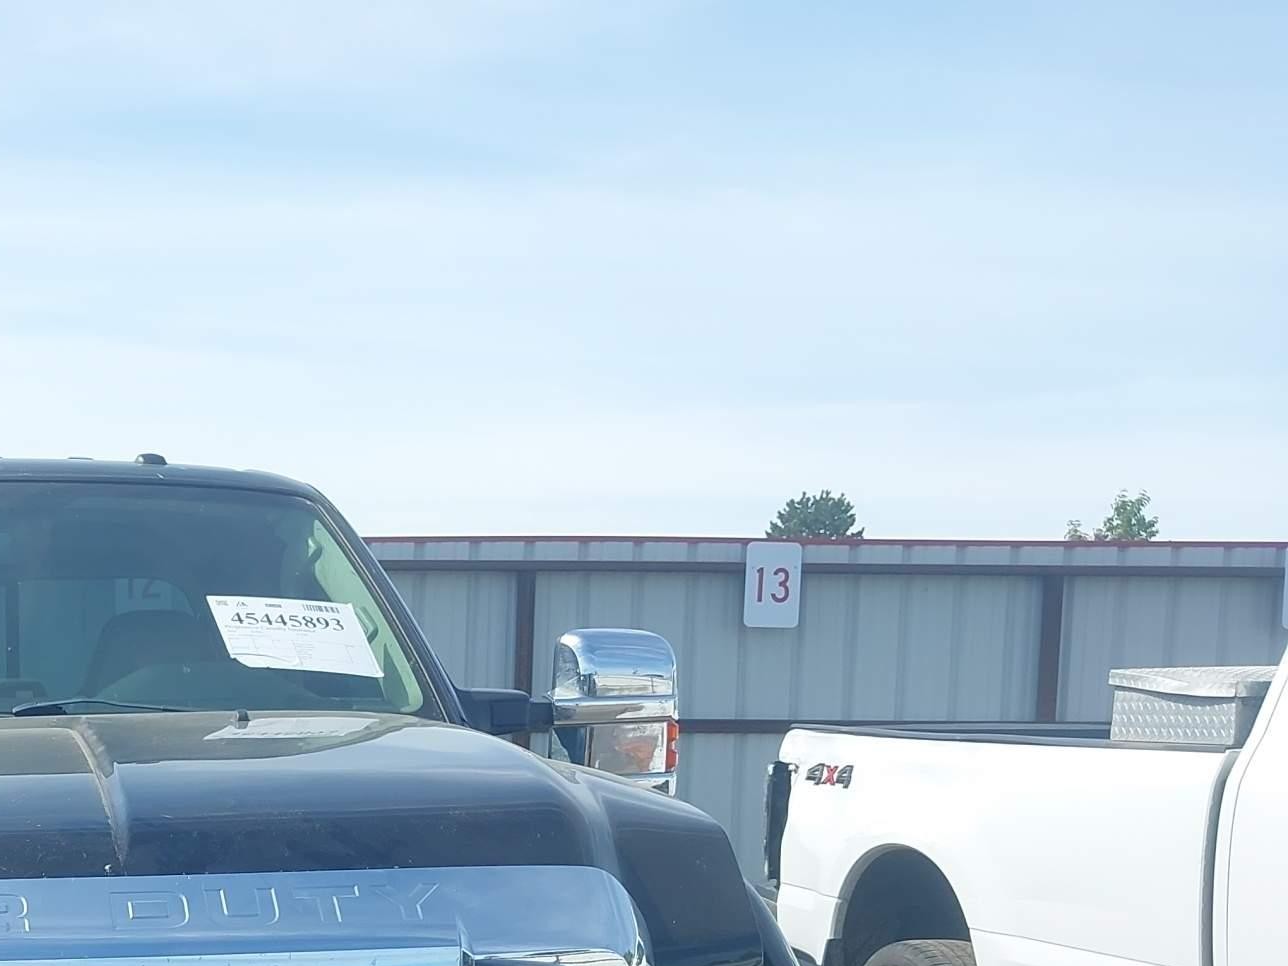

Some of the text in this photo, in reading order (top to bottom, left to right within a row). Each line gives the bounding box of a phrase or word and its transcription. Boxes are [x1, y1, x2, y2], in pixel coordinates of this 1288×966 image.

[756, 566, 790, 603] 13
[230, 611, 345, 632] 45445893
[109, 881, 440, 931] DUTY
